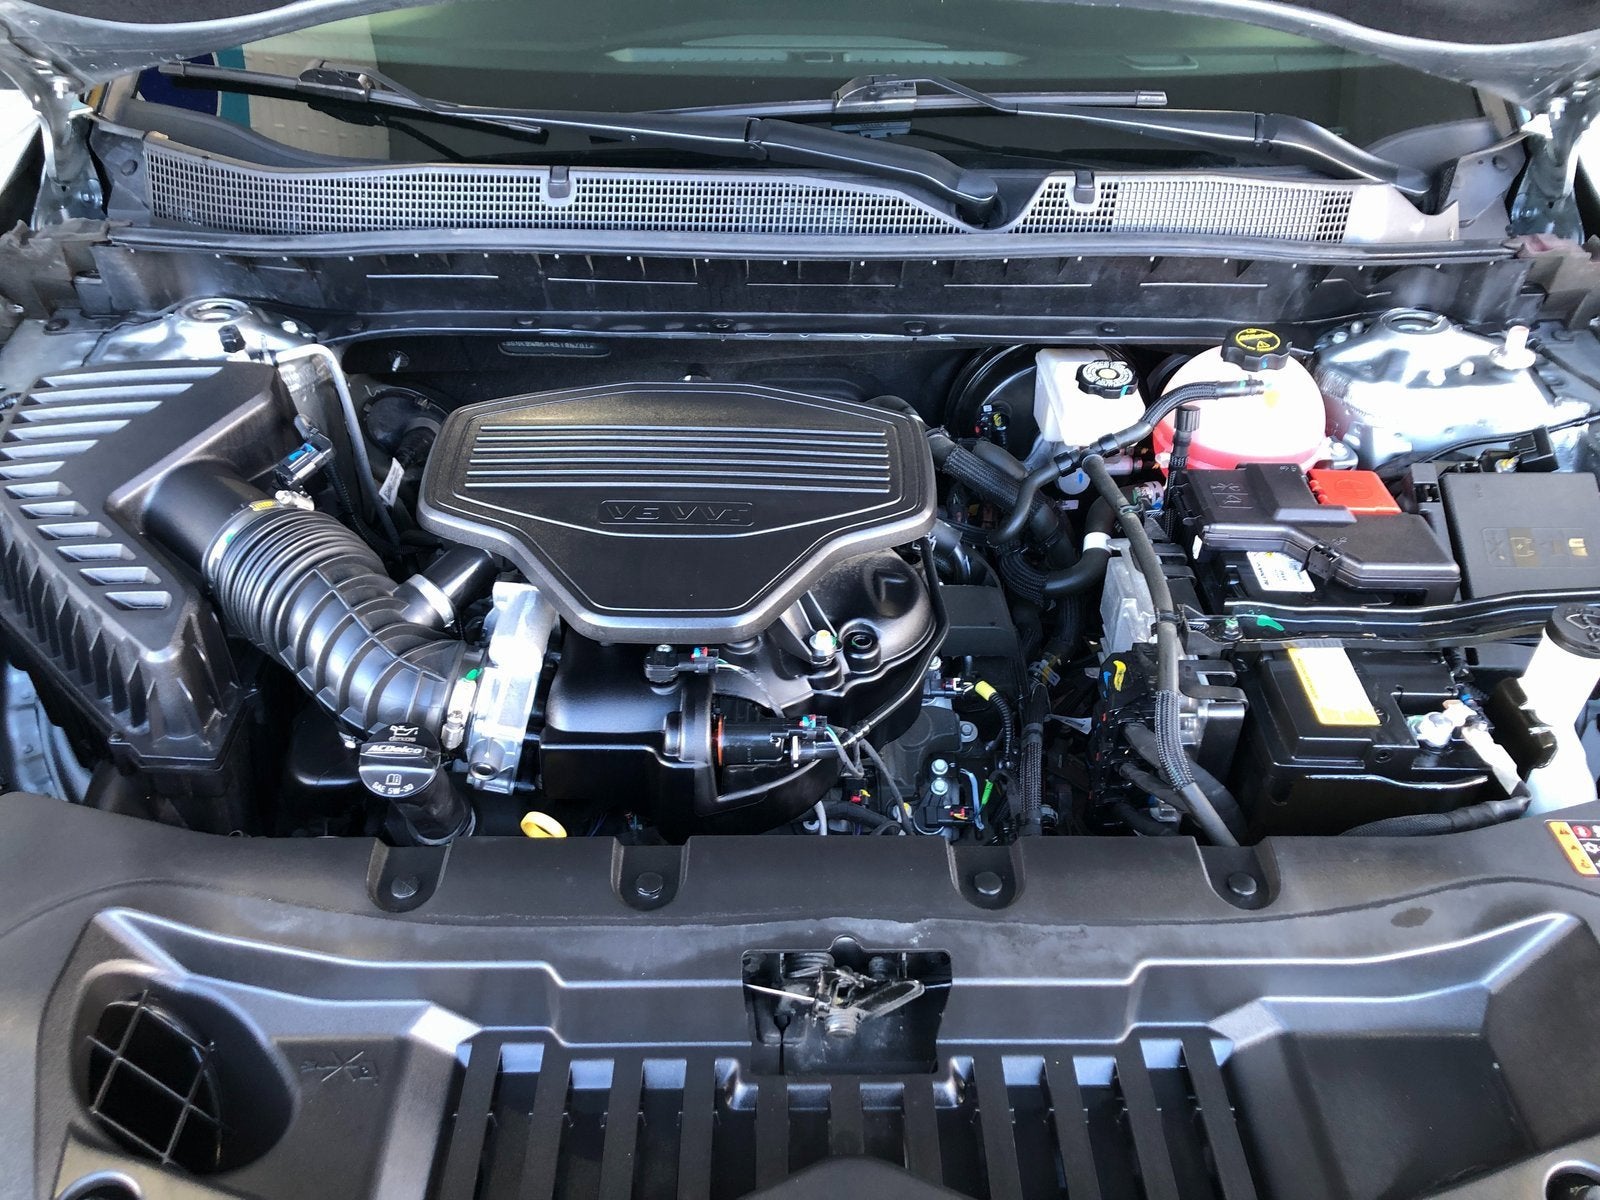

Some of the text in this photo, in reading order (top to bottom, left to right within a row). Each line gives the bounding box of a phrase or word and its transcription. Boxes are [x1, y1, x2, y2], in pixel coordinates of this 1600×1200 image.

[606, 504, 660, 520] V6
[365, 744, 423, 755] ACDelco
[371, 781, 386, 793] SAE
